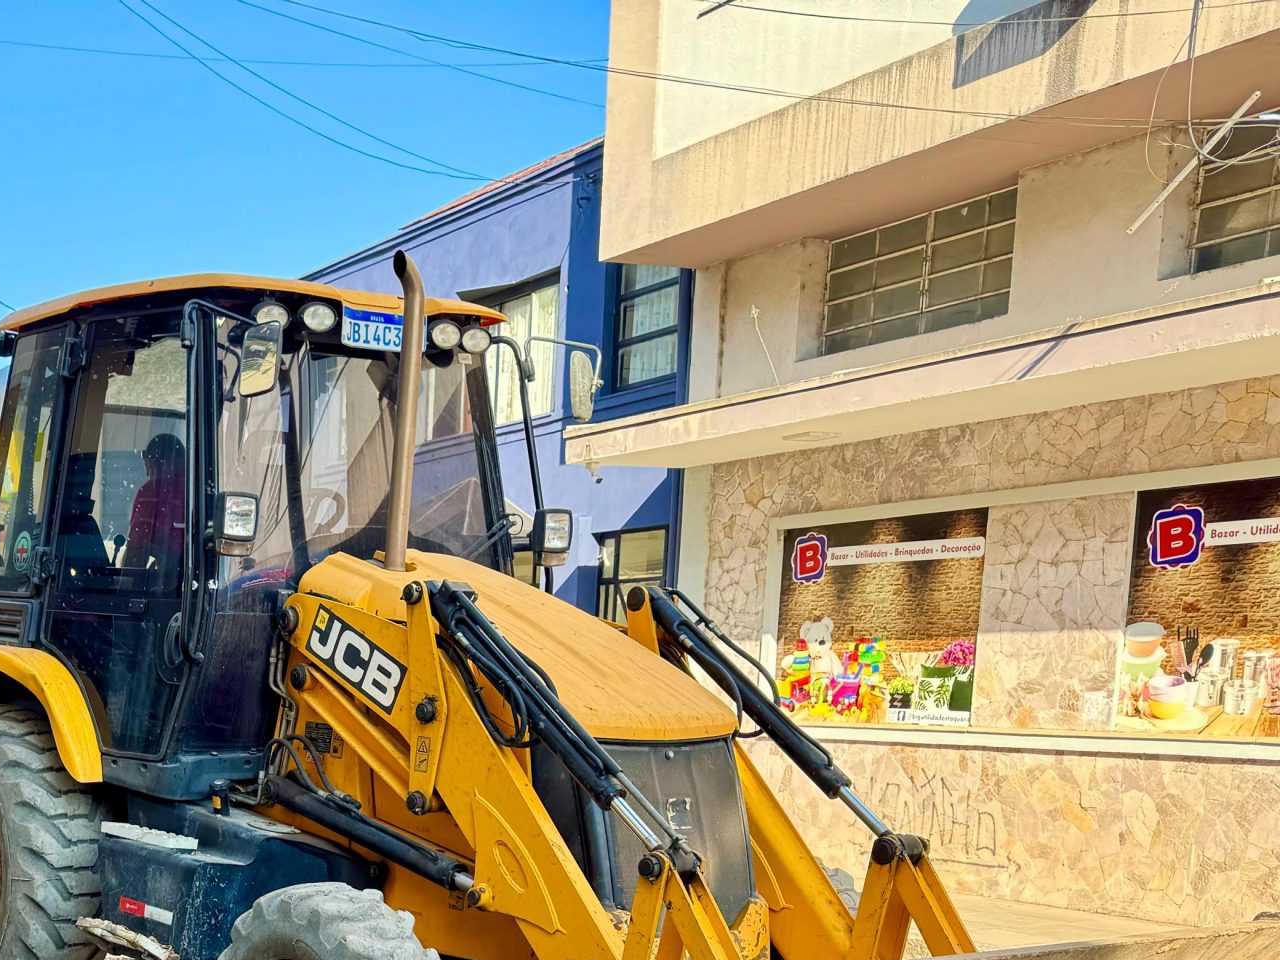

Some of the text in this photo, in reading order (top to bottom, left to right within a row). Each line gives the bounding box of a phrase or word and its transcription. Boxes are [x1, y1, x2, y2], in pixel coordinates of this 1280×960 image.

[346, 321, 402, 348] JBI4C3
[1210, 529, 1240, 539] Bazar
[830, 552, 849, 560] Bazar
[855, 549, 888, 559] Utilidades
[894, 546, 934, 557] Brinquedos
[940, 543, 981, 553] Decoração
[309, 618, 402, 708] JCB
